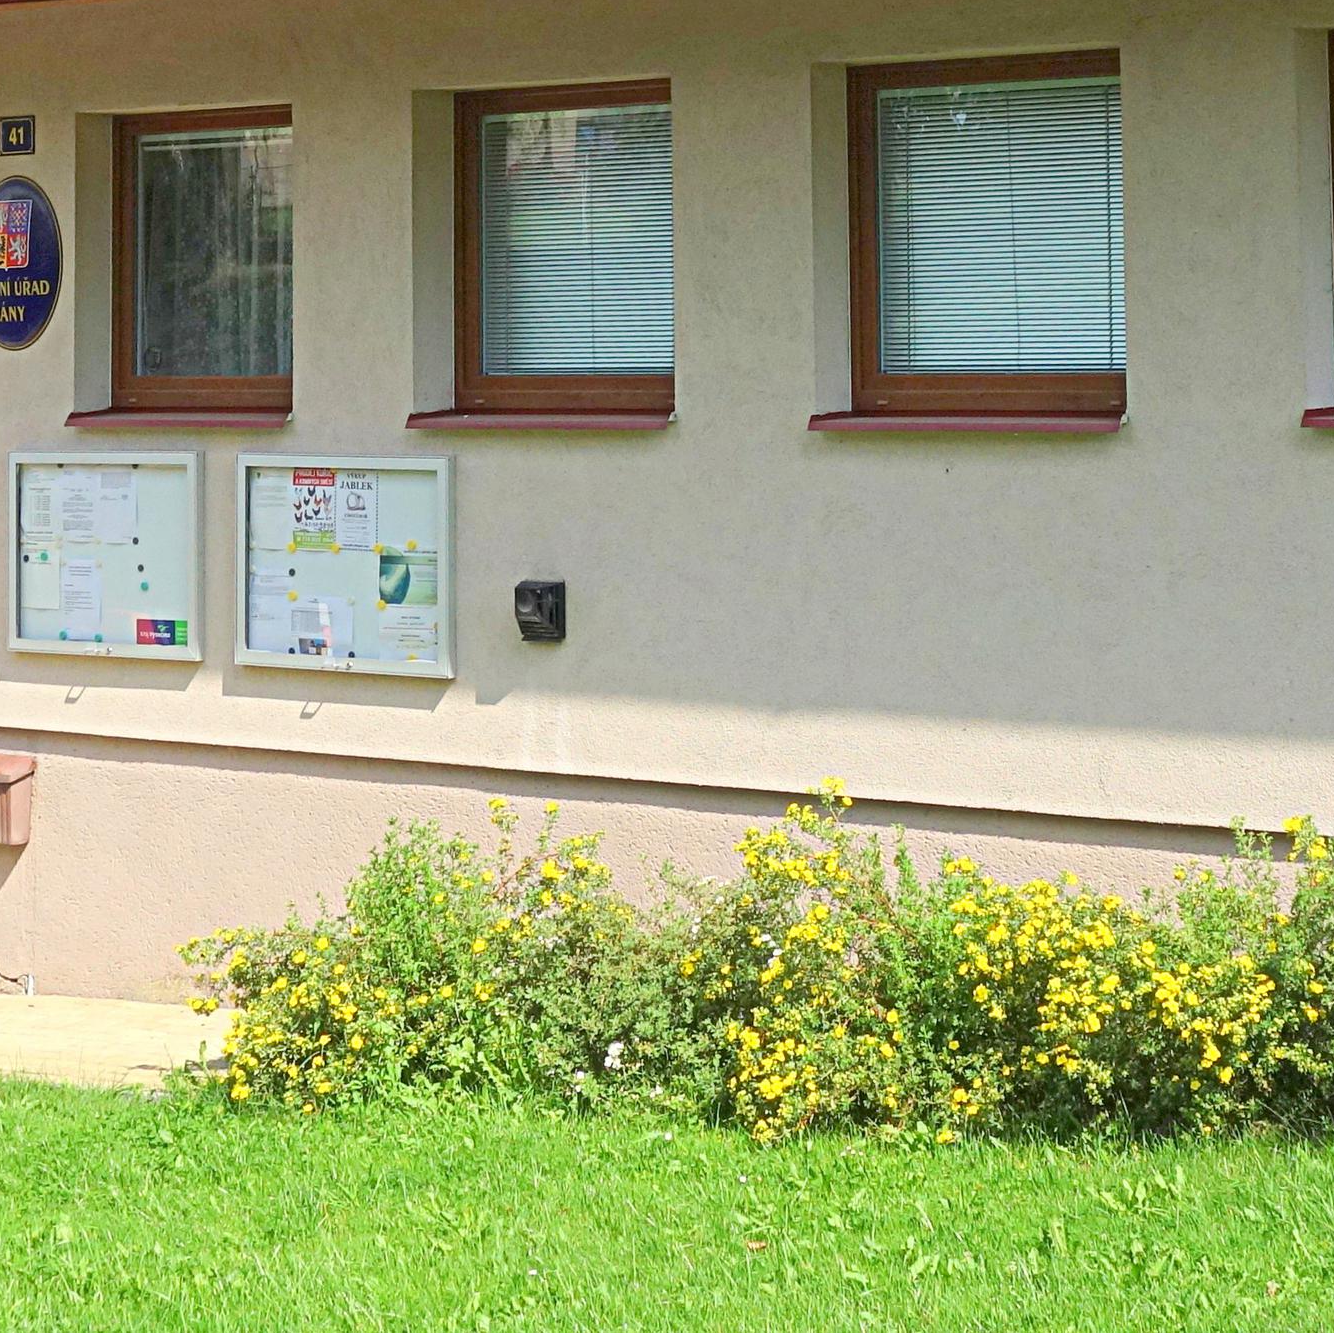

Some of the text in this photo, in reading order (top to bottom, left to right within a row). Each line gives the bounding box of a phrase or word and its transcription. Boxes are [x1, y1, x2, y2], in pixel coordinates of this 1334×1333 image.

[8, 126, 24, 145] 41
[14, 276, 50, 296] ÚŘAD
[340, 480, 373, 491] JABLEK
